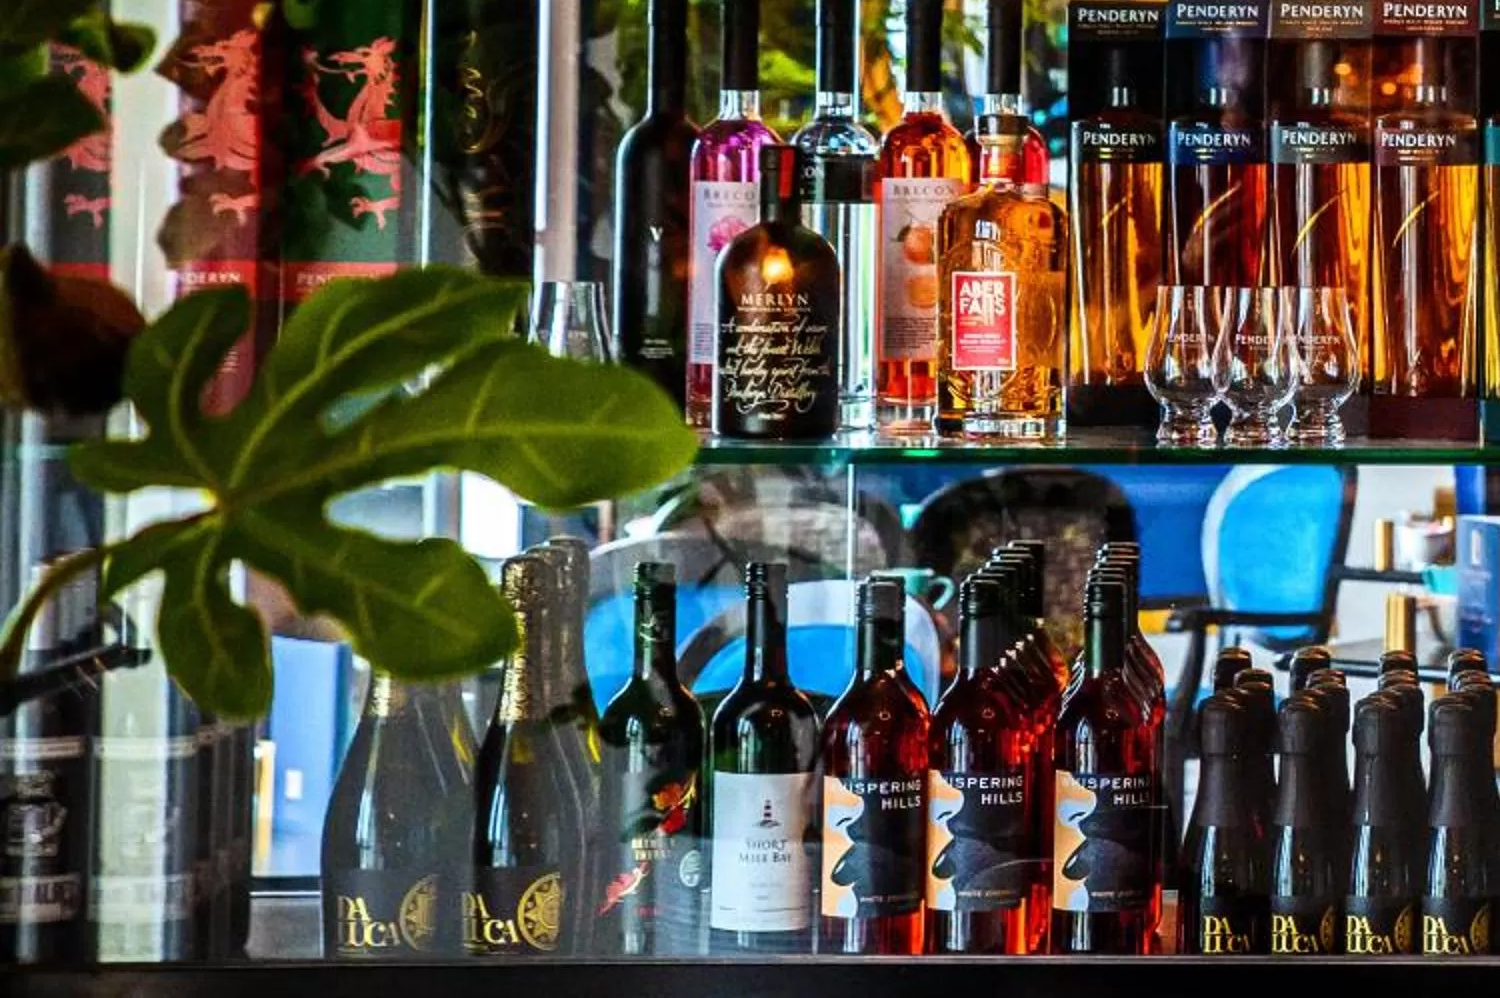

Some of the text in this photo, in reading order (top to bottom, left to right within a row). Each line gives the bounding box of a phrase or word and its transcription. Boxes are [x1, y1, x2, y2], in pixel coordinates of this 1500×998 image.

[1078, 8, 1159, 22] PENDERYN
[1177, 4, 1259, 18] PENDERYN
[1281, 3, 1363, 18] PENDERYN
[1383, 2, 1467, 18] PENDERYN
[1083, 131, 1156, 145] PENDERYN
[1178, 132, 1250, 146] PENDERYN
[1282, 130, 1357, 145] PENDERYN
[1381, 133, 1456, 147] PENDERYN
[703, 187, 756, 201] BRECO
[960, 280, 1006, 297] ABER
[741, 293, 810, 307] MERLYN
[960, 296, 1006, 326] FALLS
[881, 795, 921, 810] HILLS
[981, 791, 1024, 805] HILLS
[337, 896, 371, 921] DA
[461, 892, 491, 918] DA
[1204, 916, 1231, 934] DA
[1272, 916, 1299, 934] DA
[1347, 916, 1373, 934] DA
[1423, 916, 1449, 935] DA
[1272, 934, 1319, 952] LUCA
[1346, 934, 1392, 952] LUCA
[1423, 935, 1470, 953] LUCA
